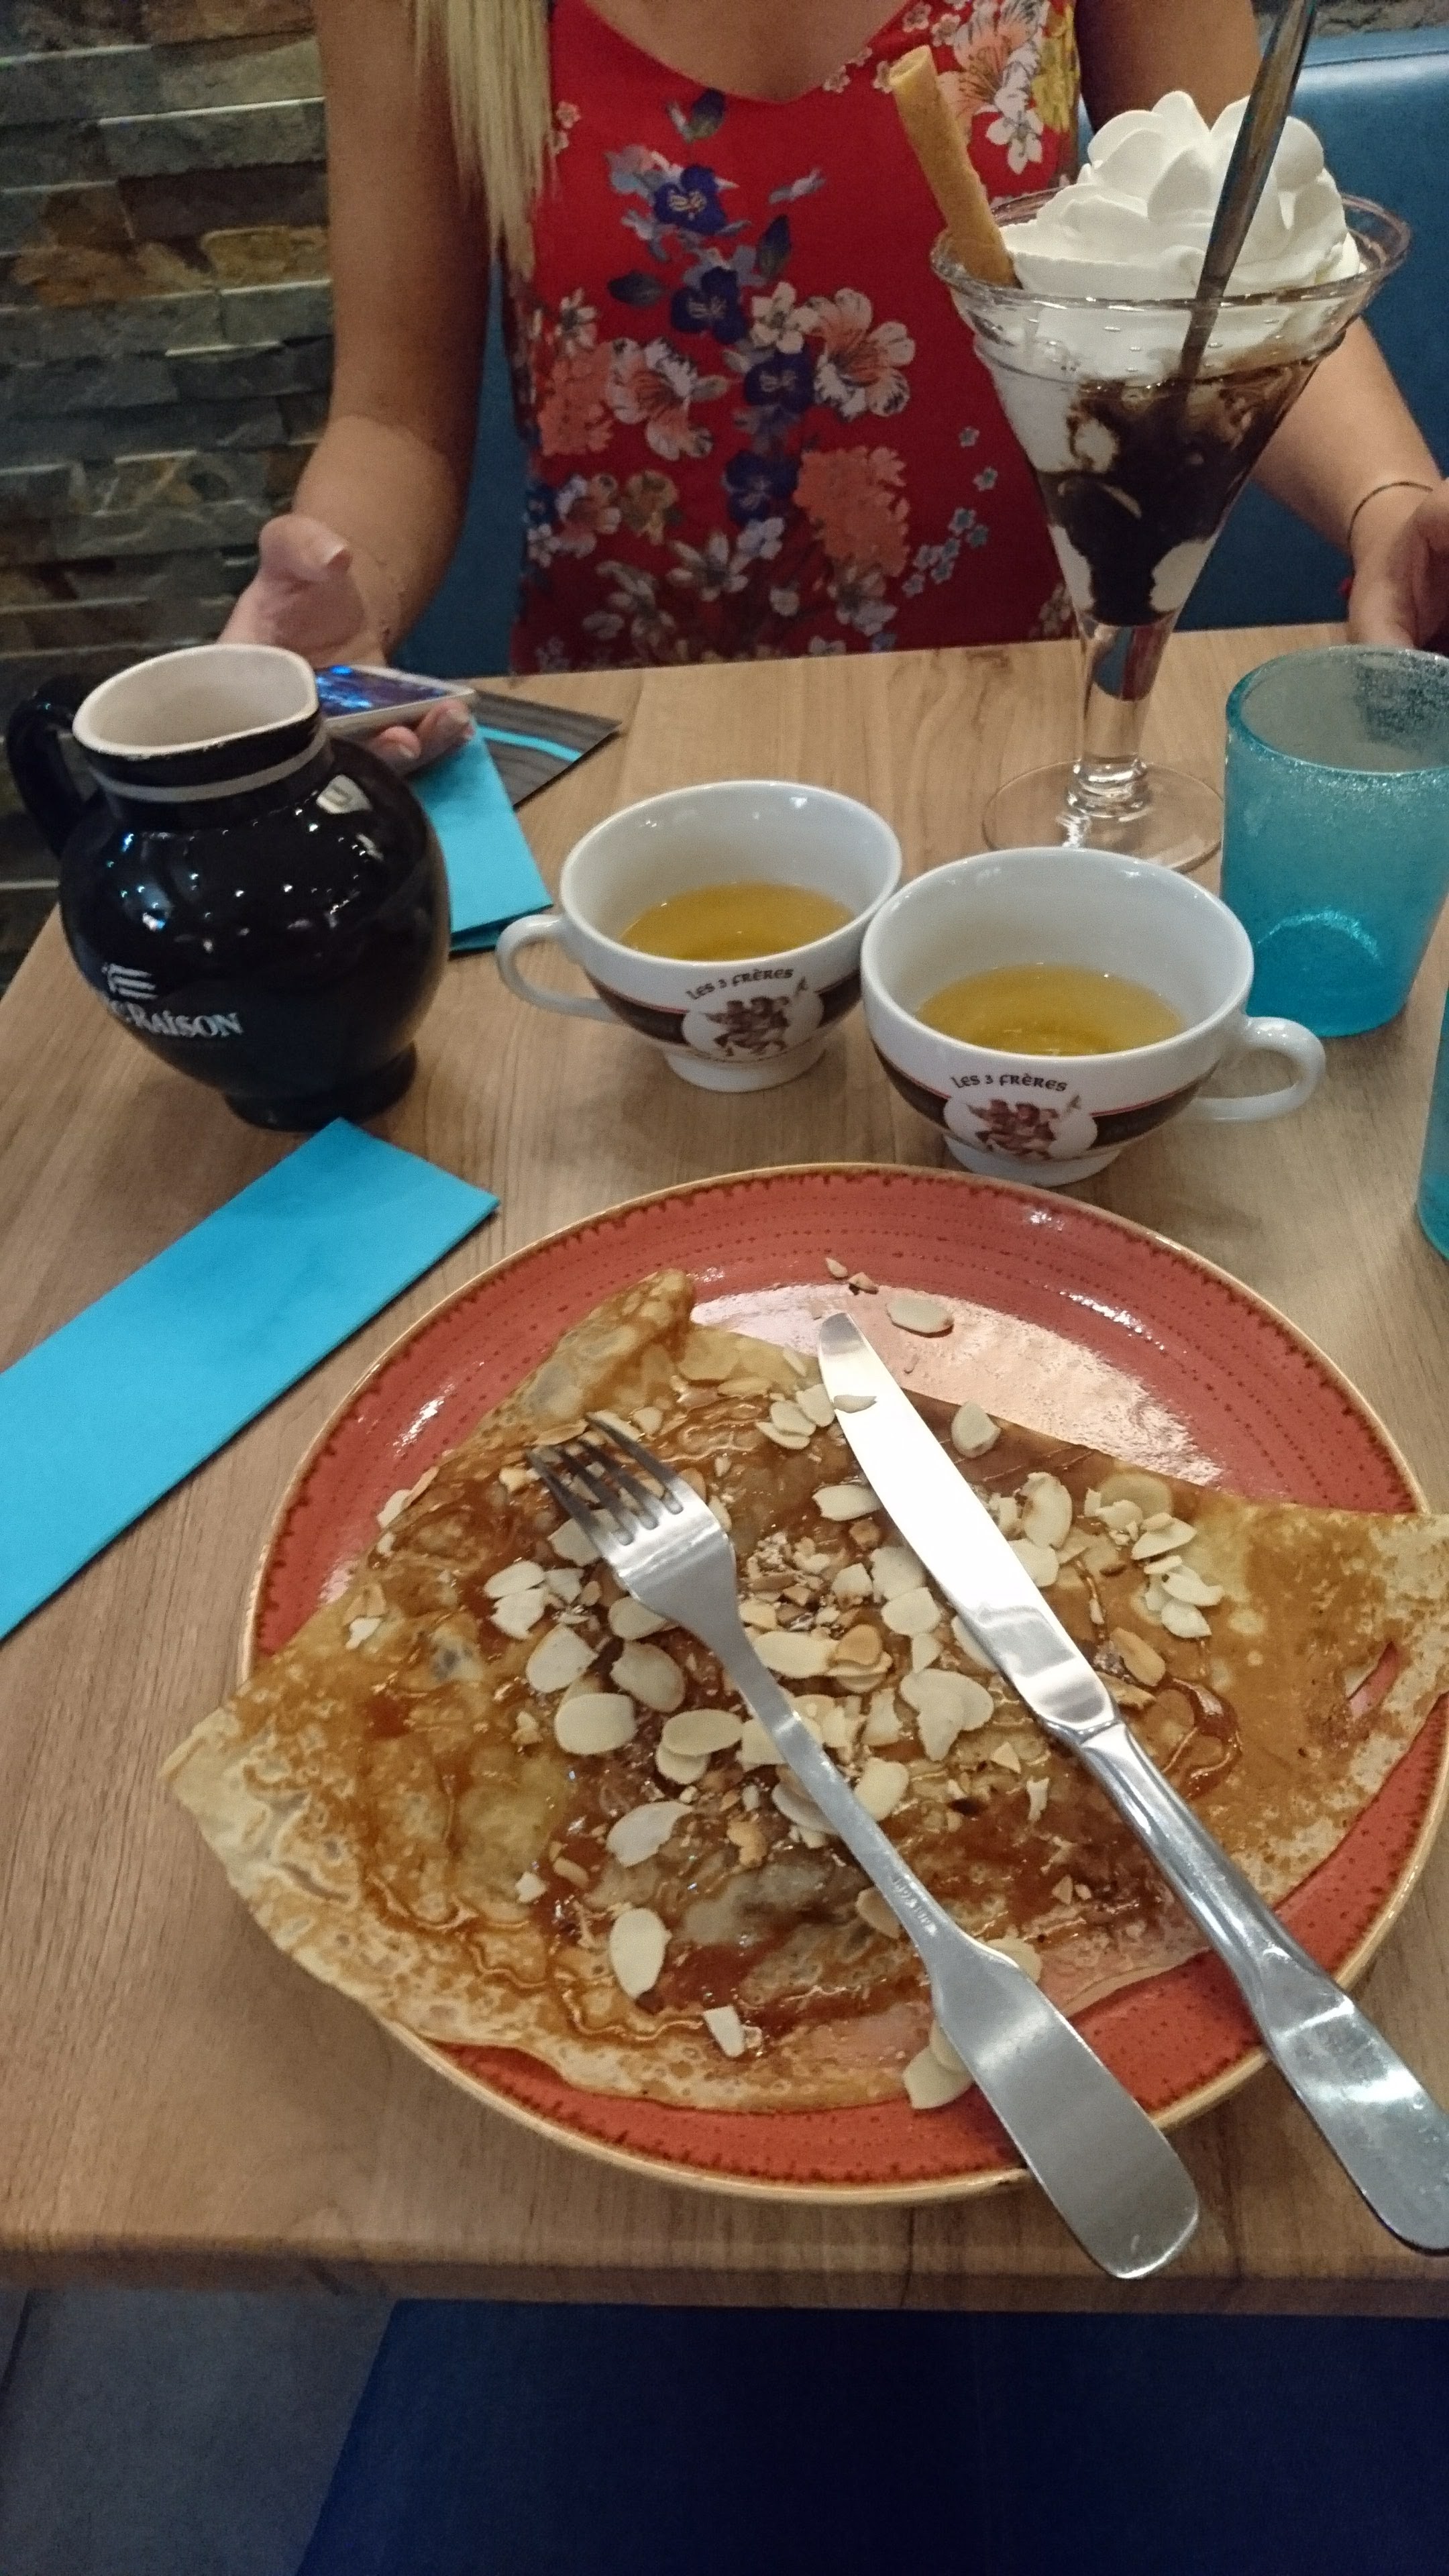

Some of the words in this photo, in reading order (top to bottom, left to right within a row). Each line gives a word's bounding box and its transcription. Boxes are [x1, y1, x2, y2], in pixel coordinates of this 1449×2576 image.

[686, 982, 716, 1000] LES
[718, 978, 728, 989] 3
[950, 1074, 981, 1089] LES
[985, 1074, 994, 1085] 3
[999, 1073, 1068, 1092] FRÈRES
